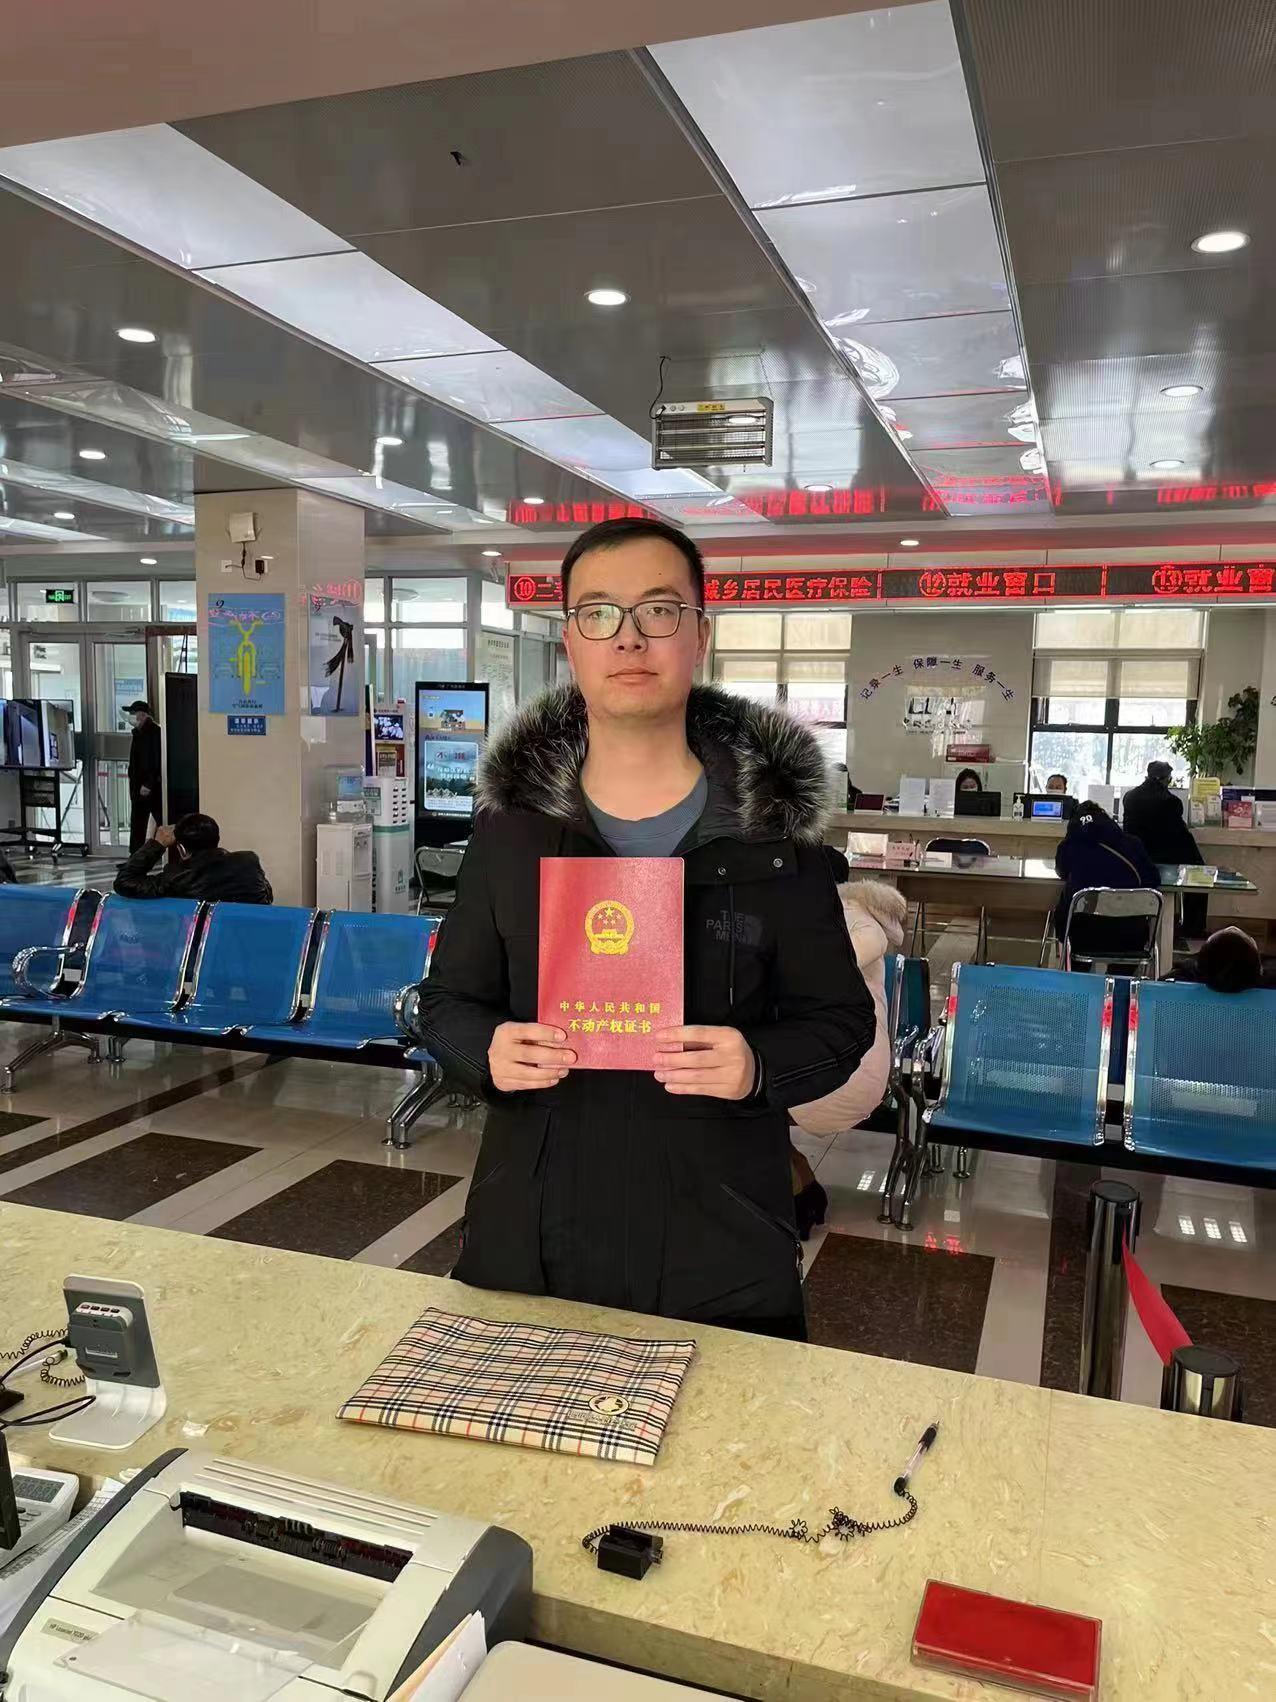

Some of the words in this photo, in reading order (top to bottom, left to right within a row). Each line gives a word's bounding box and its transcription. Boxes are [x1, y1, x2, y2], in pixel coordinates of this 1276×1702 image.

[860, 664, 904, 700] 记录一生
[913, 656, 963, 670] 保障一生
[972, 664, 1015, 701] 服务一生
[560, 1001, 660, 1014] 中华人民共和国
[568, 1019, 652, 1033] 不动产权证书
